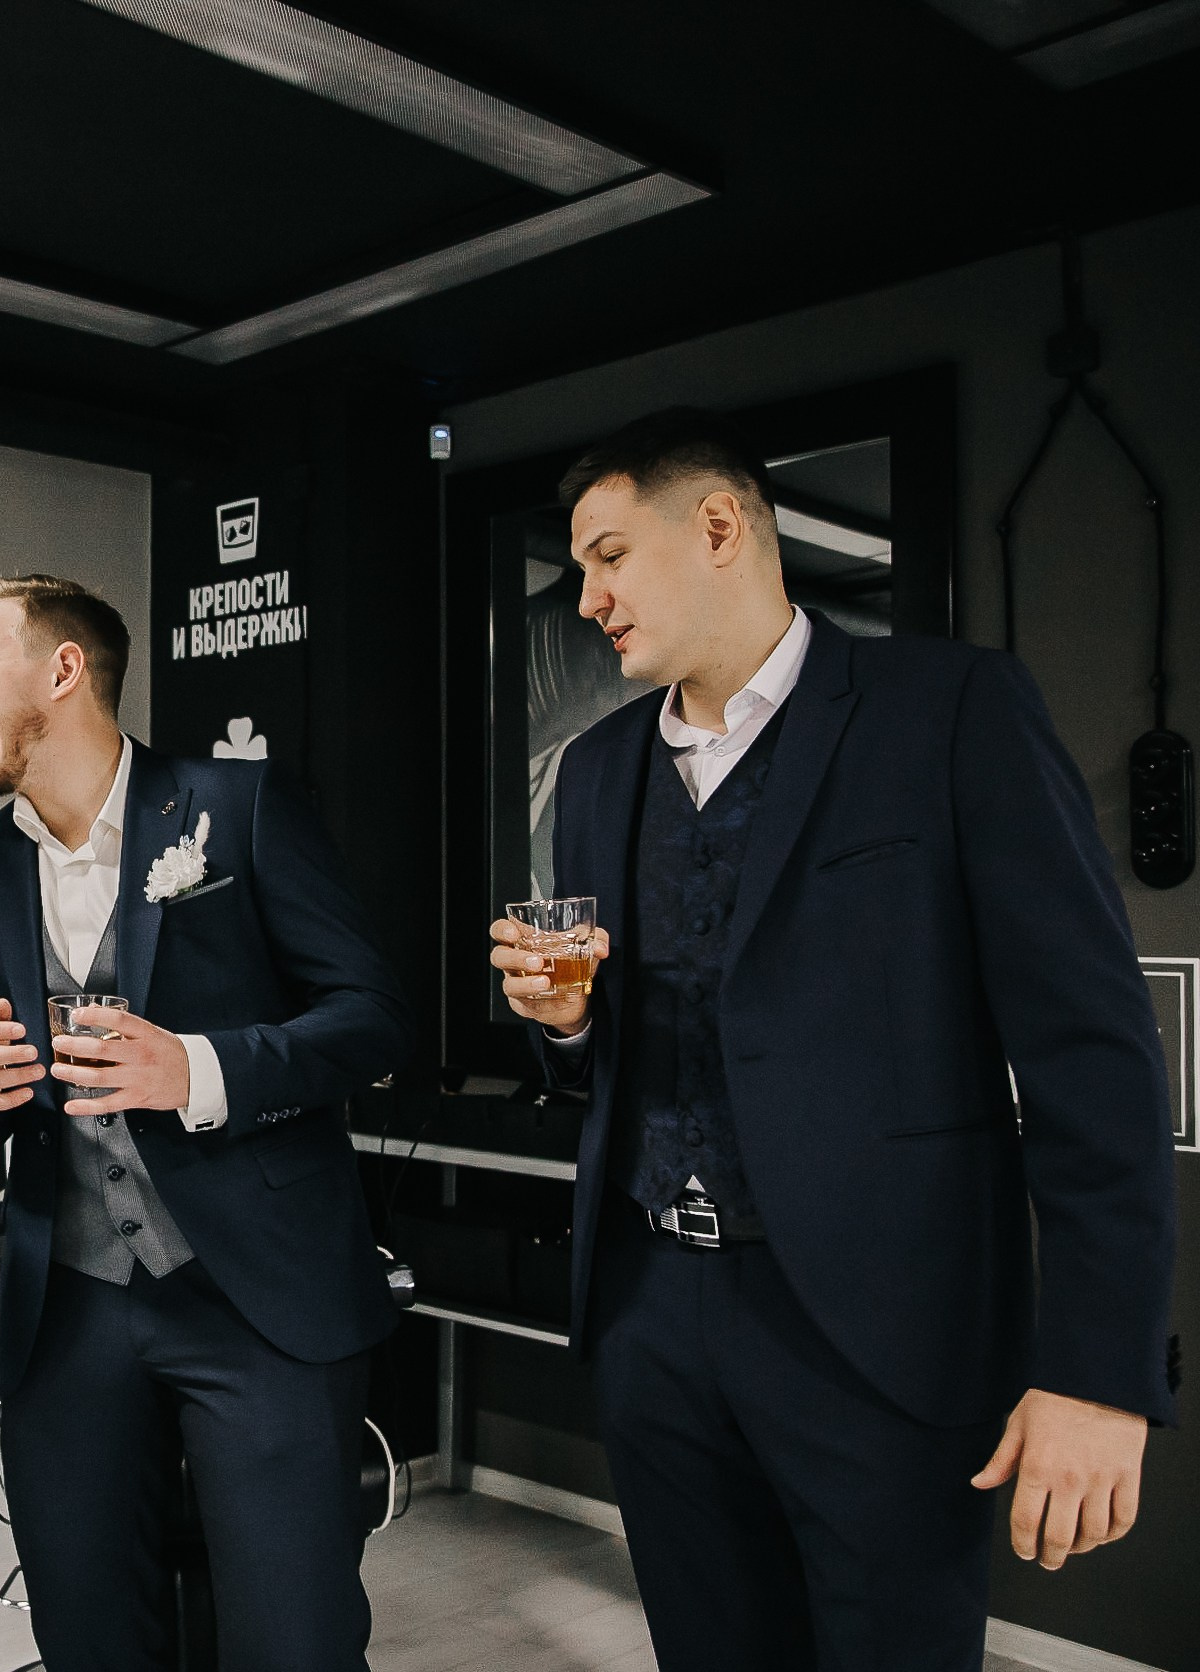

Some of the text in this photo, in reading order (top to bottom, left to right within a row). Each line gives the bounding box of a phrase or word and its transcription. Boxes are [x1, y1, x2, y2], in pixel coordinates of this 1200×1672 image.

[189, 570, 289, 621] КРЕПОСТИ
[172, 605, 307, 660] И ВЫДЕРЖКИ
